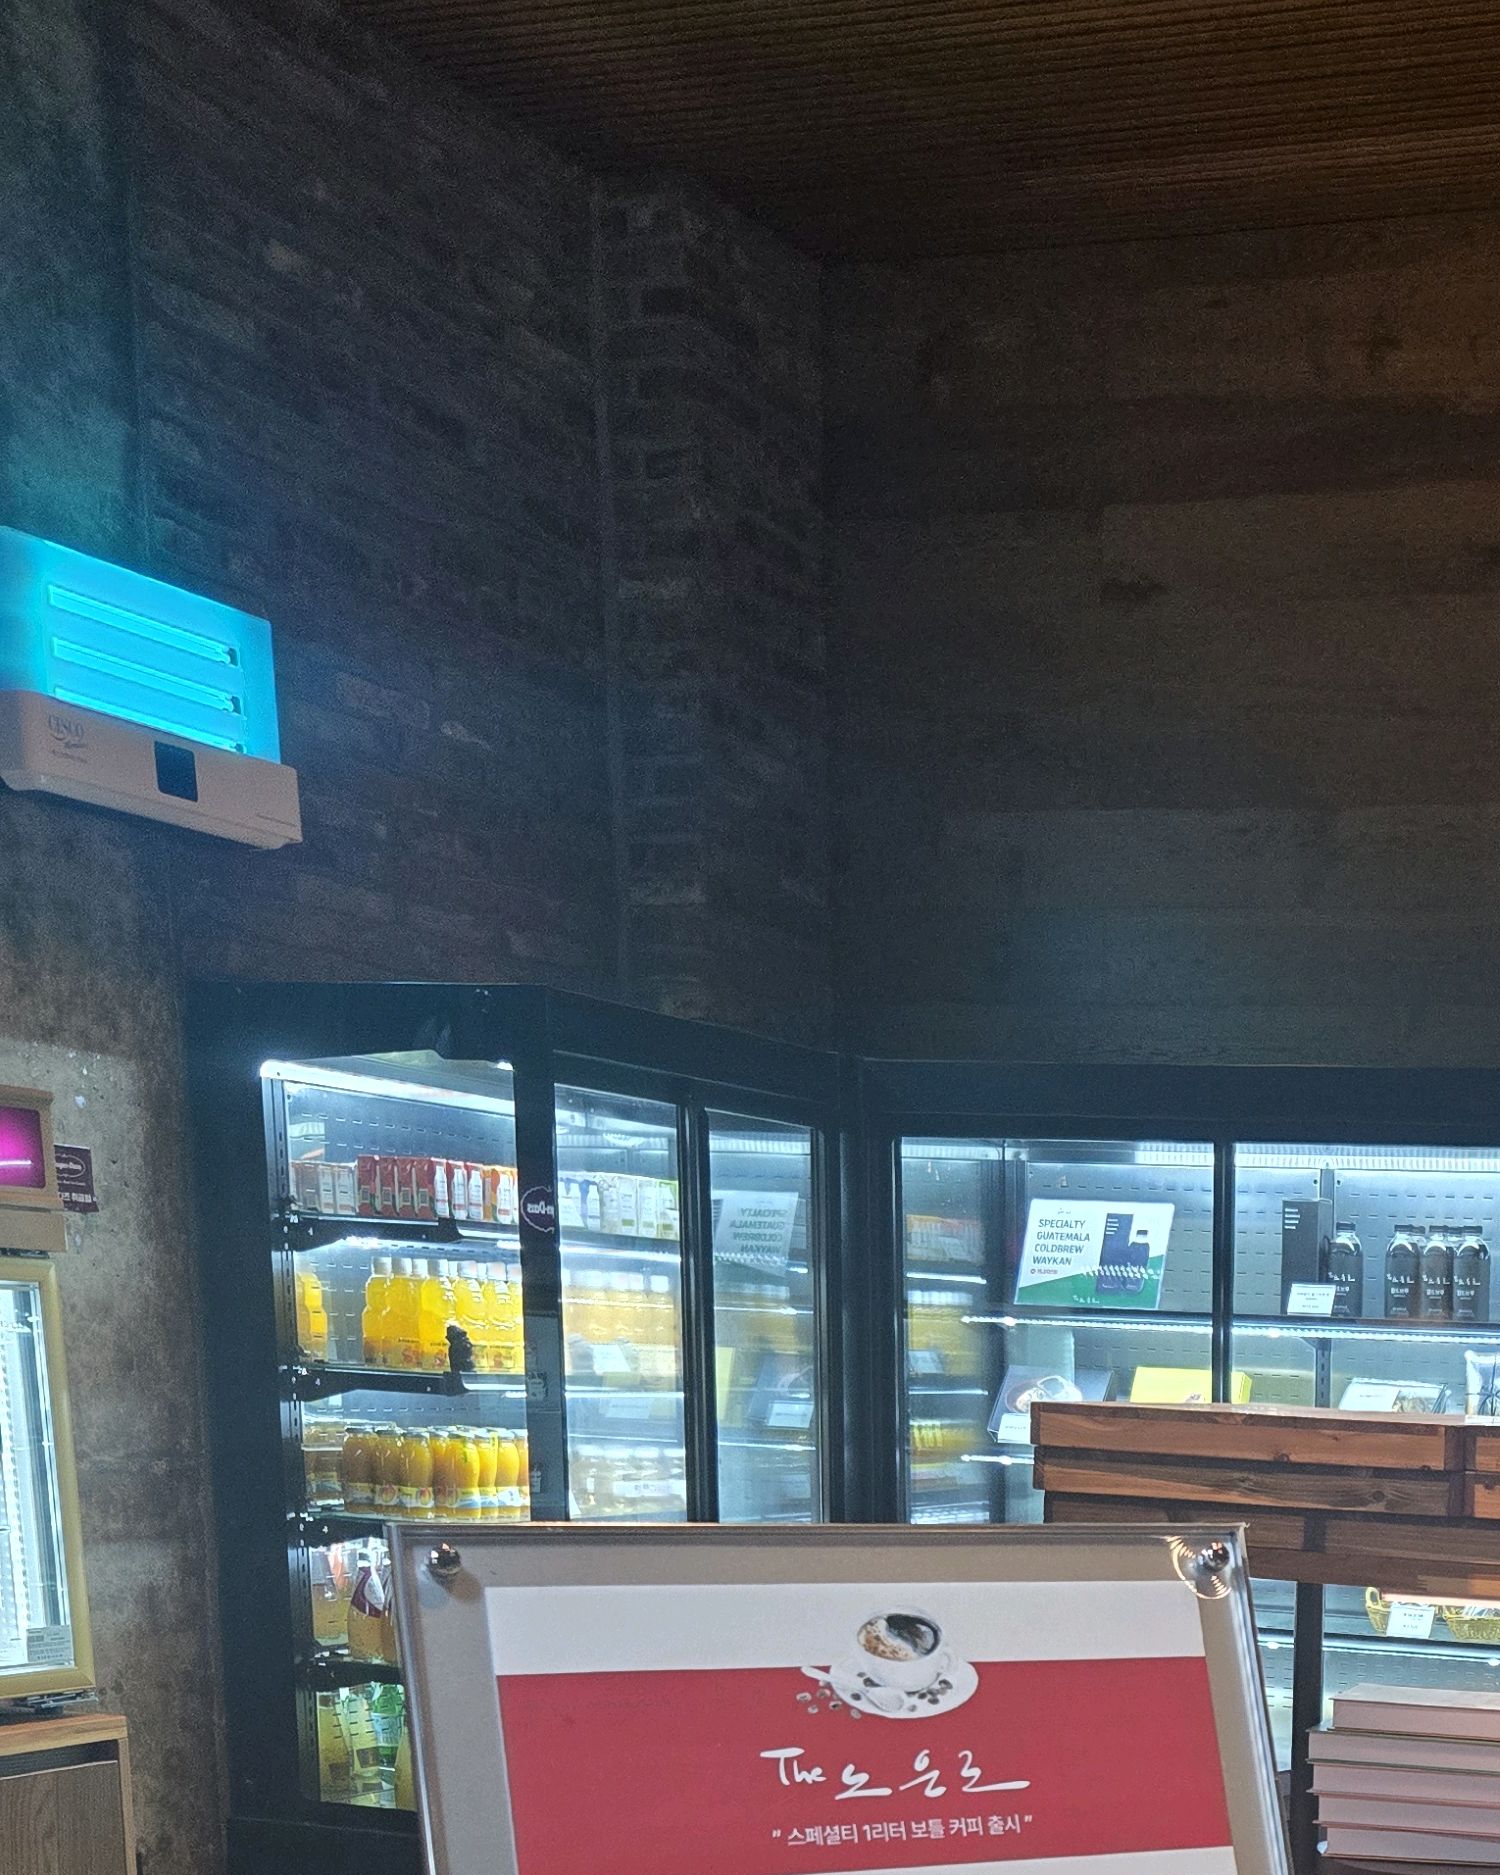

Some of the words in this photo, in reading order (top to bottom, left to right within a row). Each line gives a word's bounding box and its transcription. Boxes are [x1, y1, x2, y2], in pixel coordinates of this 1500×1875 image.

[1038, 1219, 1087, 1229] SPECIALTY
[1036, 1231, 1090, 1242] GUATEMALA
[1034, 1243, 1084, 1254] COLDBREW
[1032, 1255, 1072, 1265] WAYKAN
[760, 1747, 827, 1786] The
[835, 1749, 1031, 1800] 노은로
[787, 1824, 858, 1846] 스페셜티
[862, 1820, 907, 1841] 1리터
[911, 1818, 946, 1839] 보틀
[949, 1816, 983, 1837] 커피
[987, 1814, 1021, 1835] 출시
